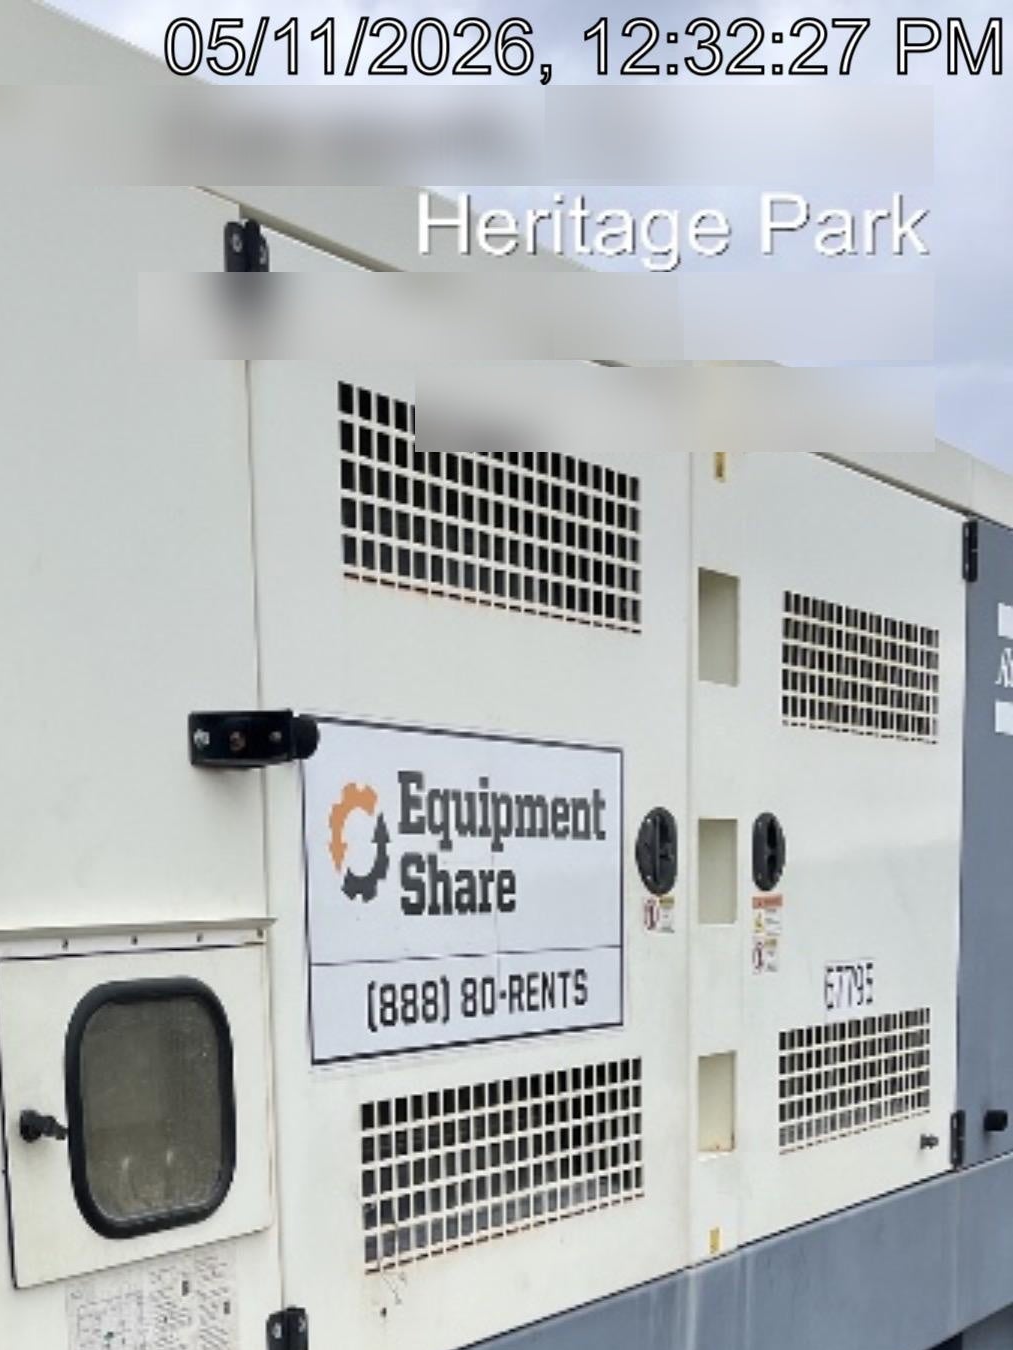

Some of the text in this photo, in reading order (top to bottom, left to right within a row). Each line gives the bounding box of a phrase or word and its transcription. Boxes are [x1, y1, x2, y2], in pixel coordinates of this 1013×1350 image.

[397, 770, 606, 852] Equipment
[400, 852, 517, 917] Share
[366, 968, 588, 1033] (888) 80-RENTS
